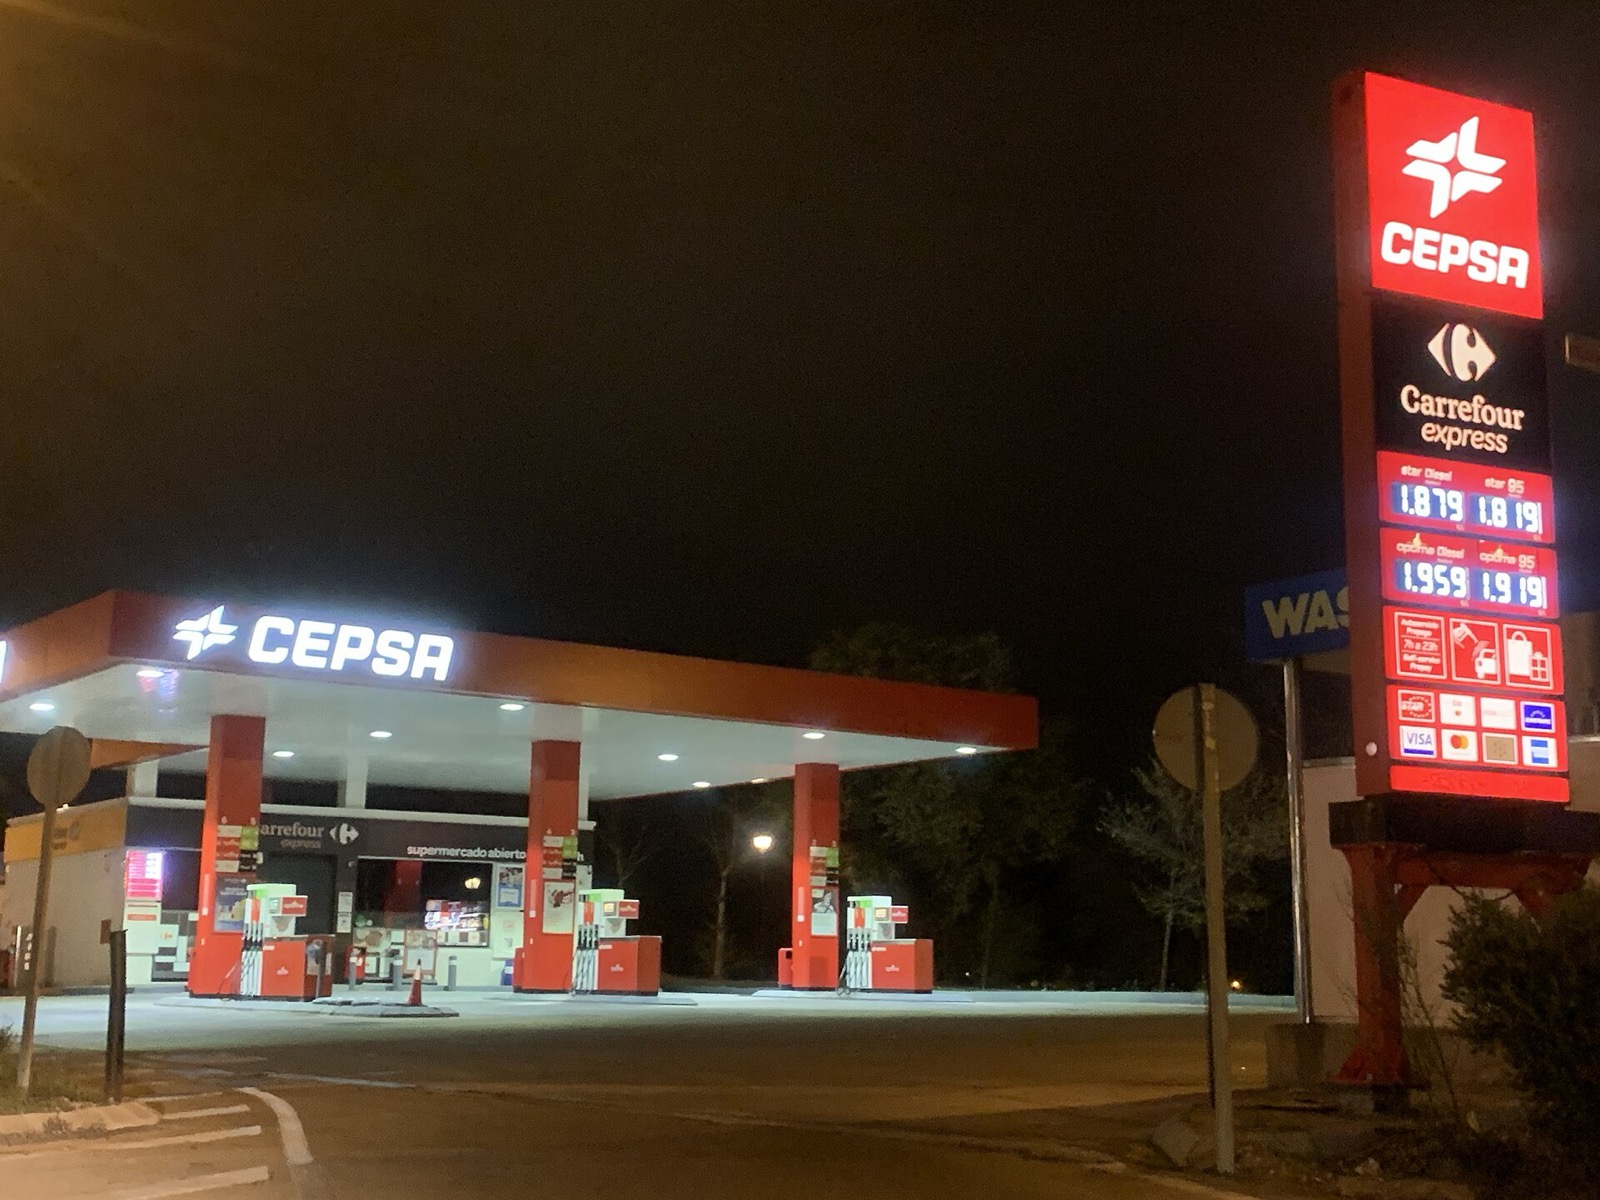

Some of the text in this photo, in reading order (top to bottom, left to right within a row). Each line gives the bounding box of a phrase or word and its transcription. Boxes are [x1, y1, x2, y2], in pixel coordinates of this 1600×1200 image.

[1381, 221, 1529, 289] CEPSA
[1400, 384, 1525, 430] Carrefour
[1421, 422, 1508, 454] express
[1401, 464, 1453, 481] star Diesel
[1485, 477, 1525, 494] star 95
[1401, 484, 1464, 522] 1.879
[1479, 496, 1539, 533] 1.819
[1518, 554, 1536, 570] 95
[1404, 561, 1467, 598] 1.959
[1483, 571, 1543, 608] 1.919
[249, 615, 454, 681] CEPSA
[1407, 732, 1432, 746] VISA
[260, 822, 325, 838] arrefour
[407, 845, 526, 860] supermercado abierto
